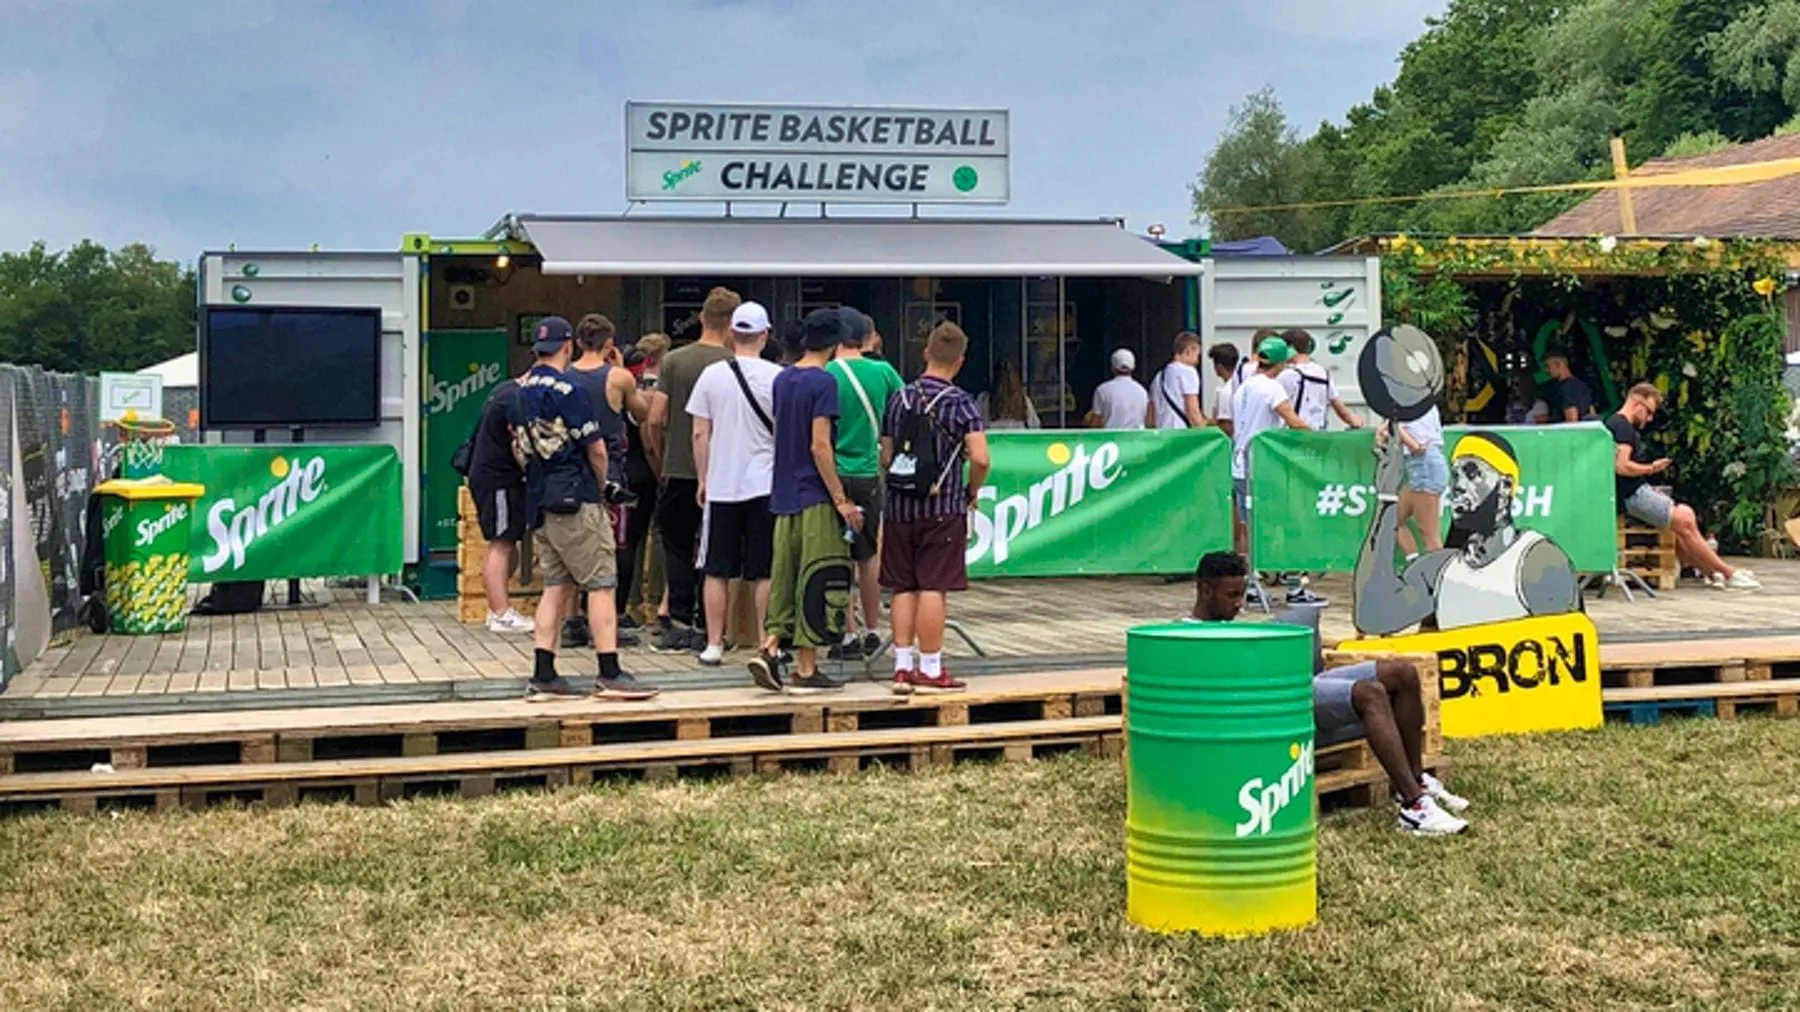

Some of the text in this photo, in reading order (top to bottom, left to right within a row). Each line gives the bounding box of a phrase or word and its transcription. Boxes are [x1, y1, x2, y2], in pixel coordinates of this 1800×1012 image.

[646, 111, 995, 146] SPRITE BASKETBALL
[661, 159, 702, 190] Sprite
[721, 161, 930, 191] CHALLENGE
[430, 361, 501, 414] Sprite
[202, 455, 326, 573] Sprite
[965, 440, 1122, 565] Sprite
[134, 503, 188, 547] Sprite
